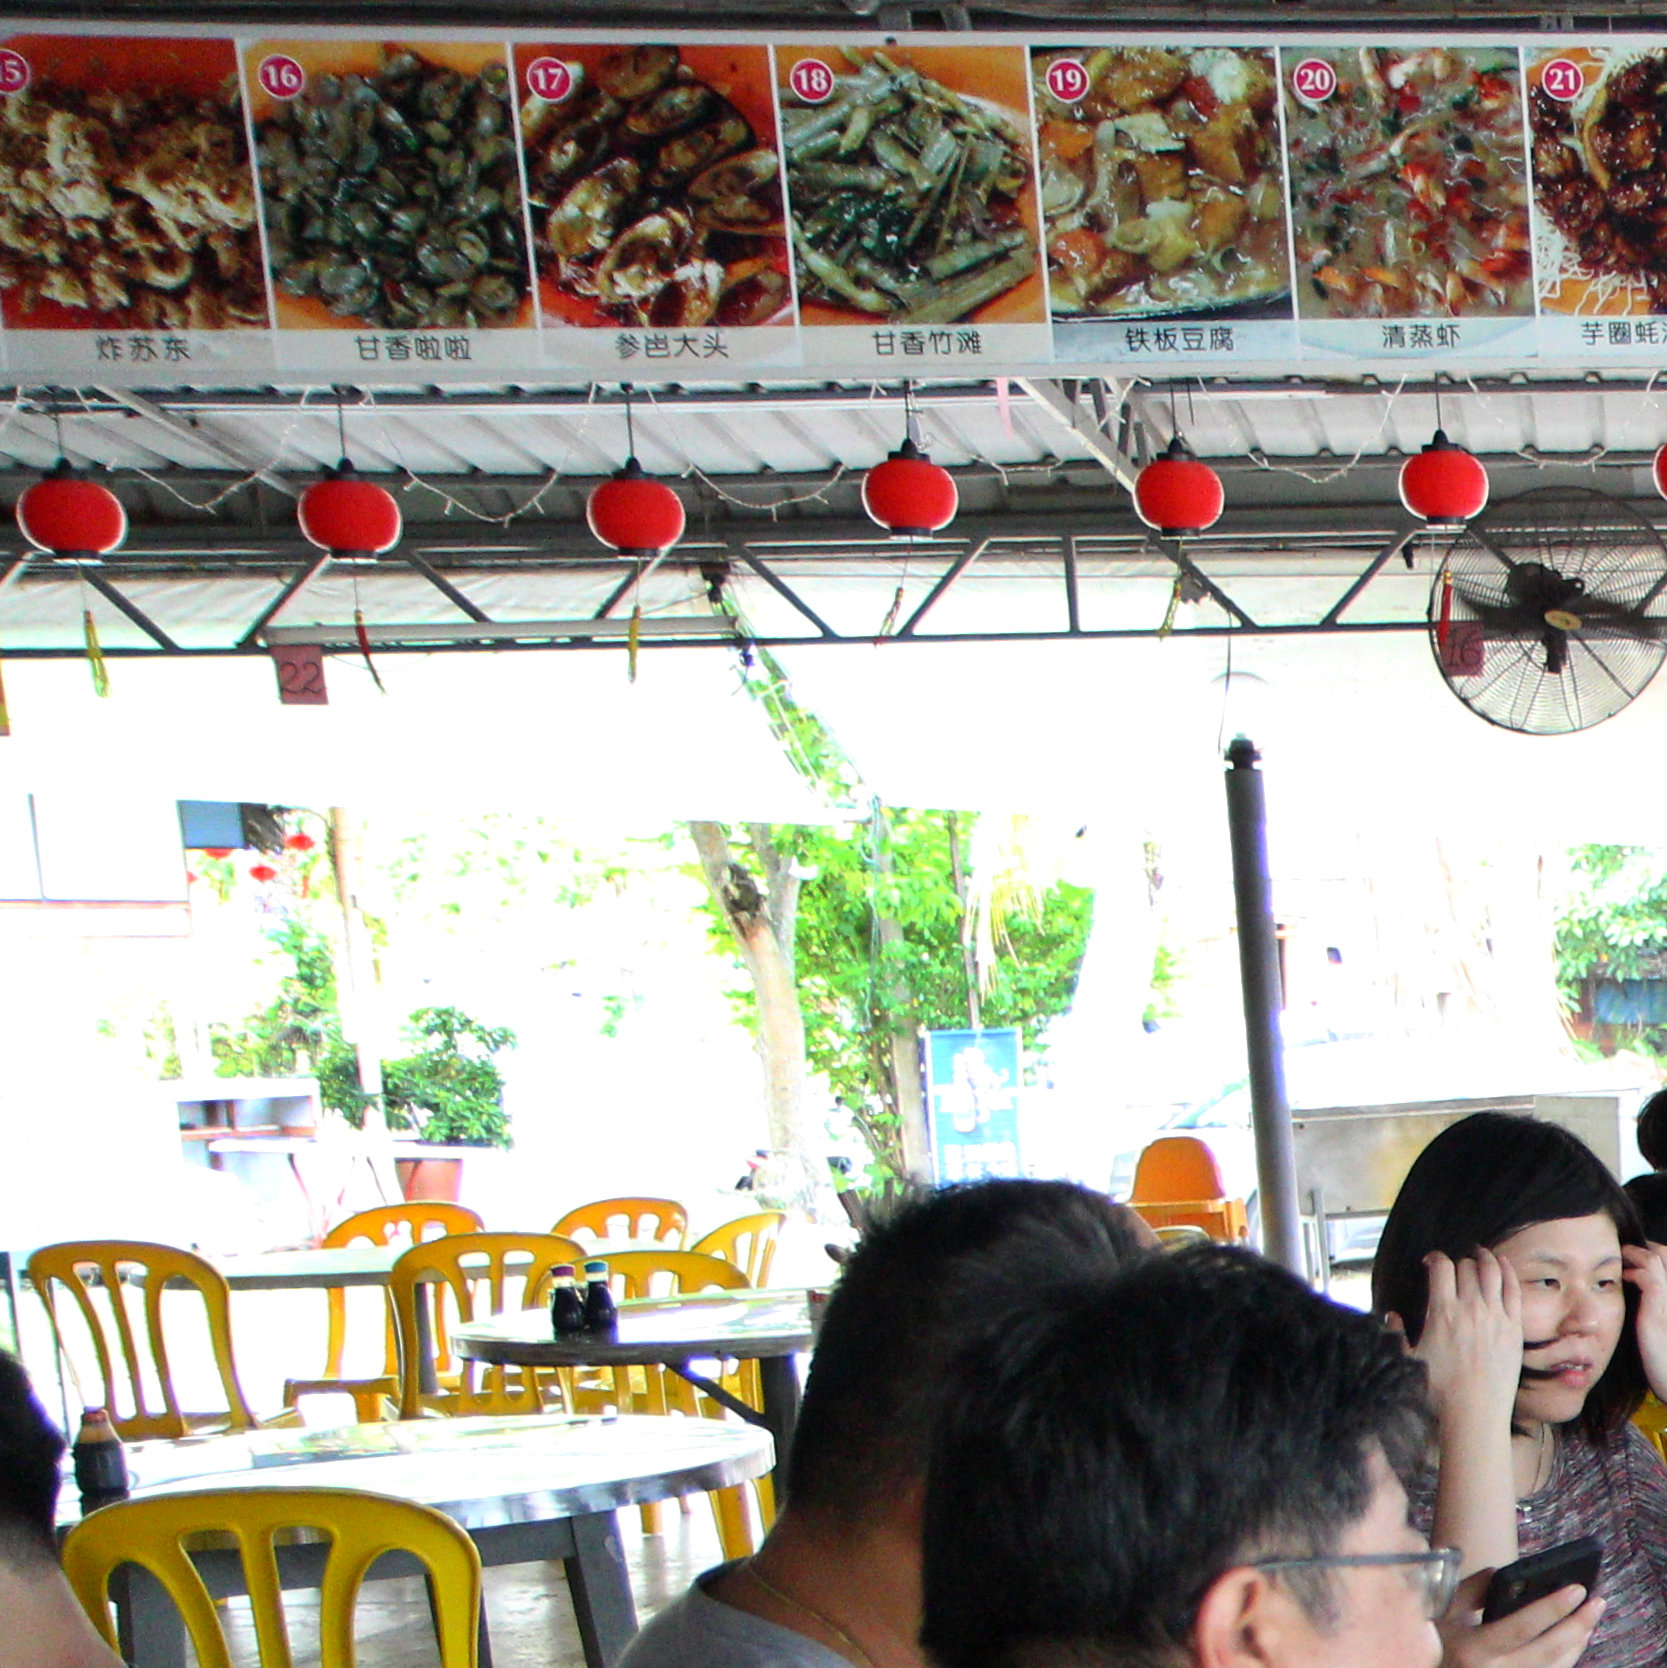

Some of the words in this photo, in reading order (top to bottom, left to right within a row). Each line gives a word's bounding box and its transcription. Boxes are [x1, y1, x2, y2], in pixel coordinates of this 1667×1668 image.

[0, 58, 22, 84] 5
[263, 64, 300, 89] 16
[533, 67, 564, 91] 17
[796, 67, 829, 93] 18
[1051, 68, 1082, 92] 19
[1299, 68, 1331, 92] 20
[1548, 68, 1576, 91] 21
[94, 334, 192, 363] 炸苏东
[354, 333, 473, 362] 甘香啦啦
[870, 329, 984, 357] 甘香竹滩
[1124, 326, 1236, 353] 铁板豆腐
[1381, 323, 1462, 349] 清蒸虾
[279, 660, 324, 694] 22
